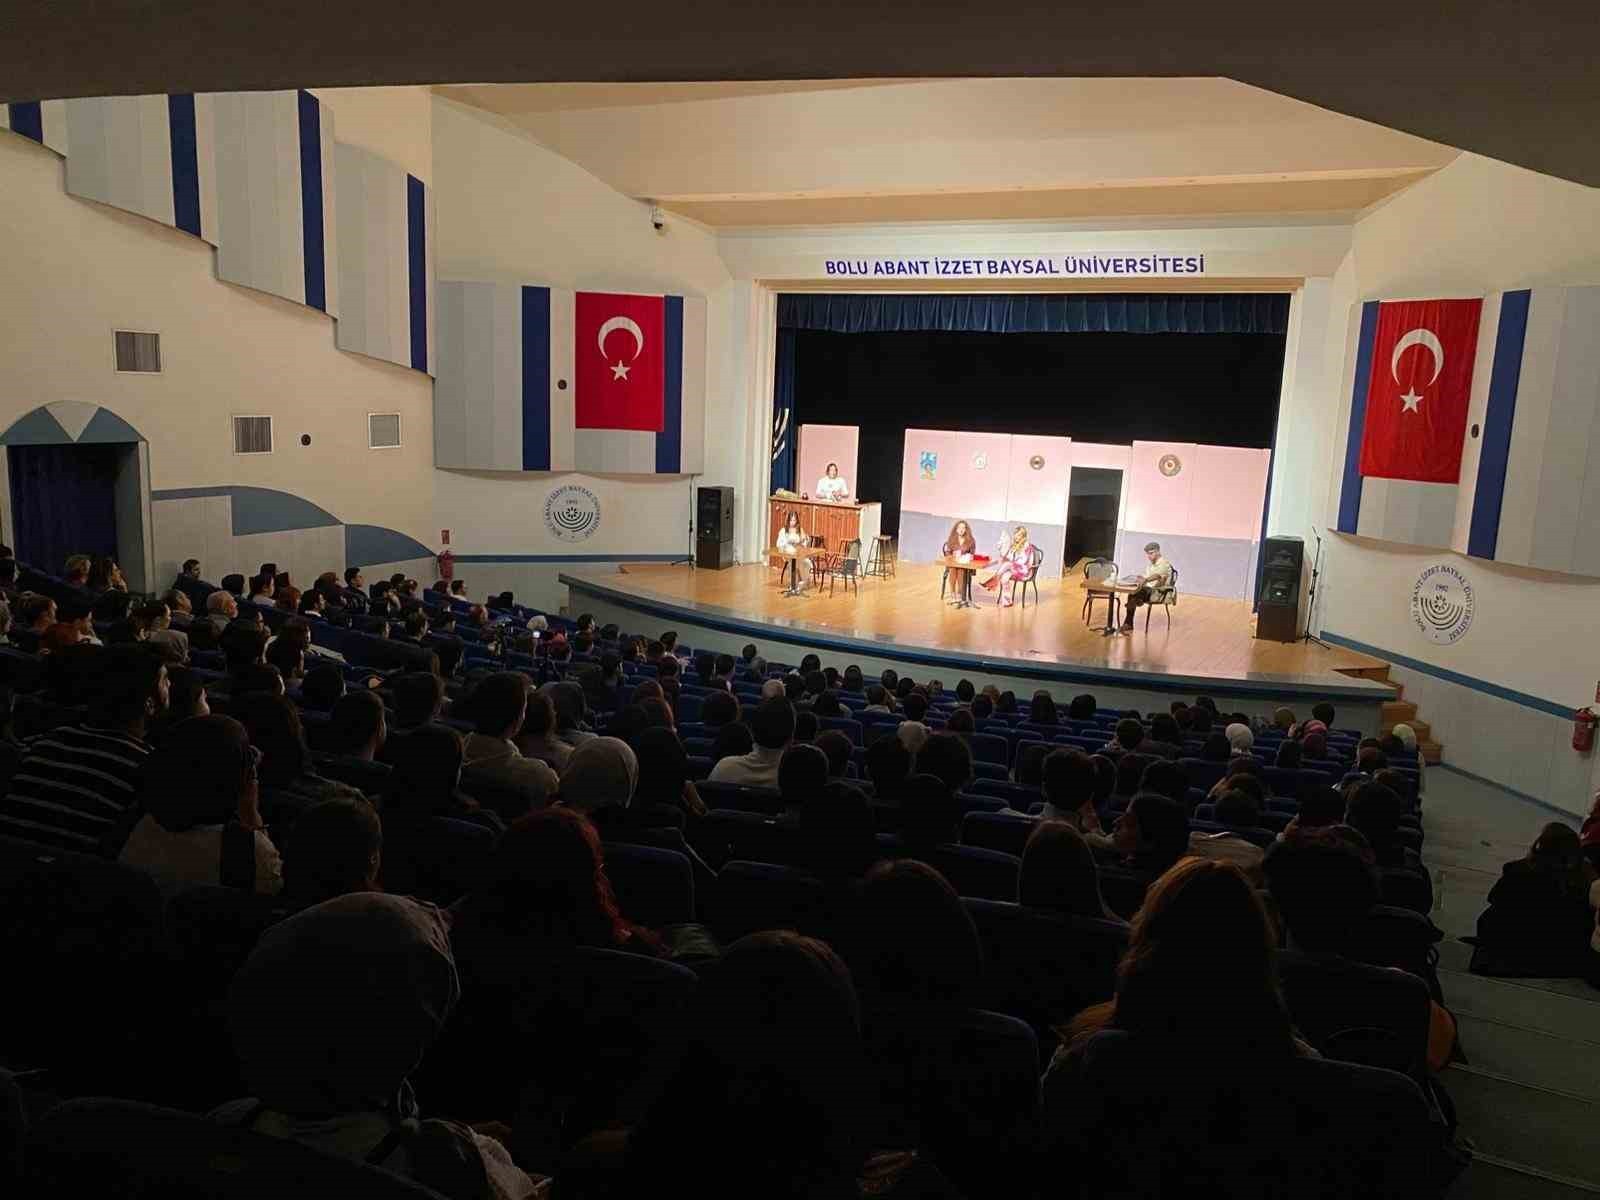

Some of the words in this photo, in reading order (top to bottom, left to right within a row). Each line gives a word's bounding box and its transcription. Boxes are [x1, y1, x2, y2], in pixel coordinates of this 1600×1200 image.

[825, 260, 868, 275] BOLU
[873, 260, 930, 275] ABANT
[934, 256, 983, 275] İZZET
[987, 259, 1060, 274] BAYSAL
[1064, 254, 1204, 274] ÜNİVERSİTESİ
